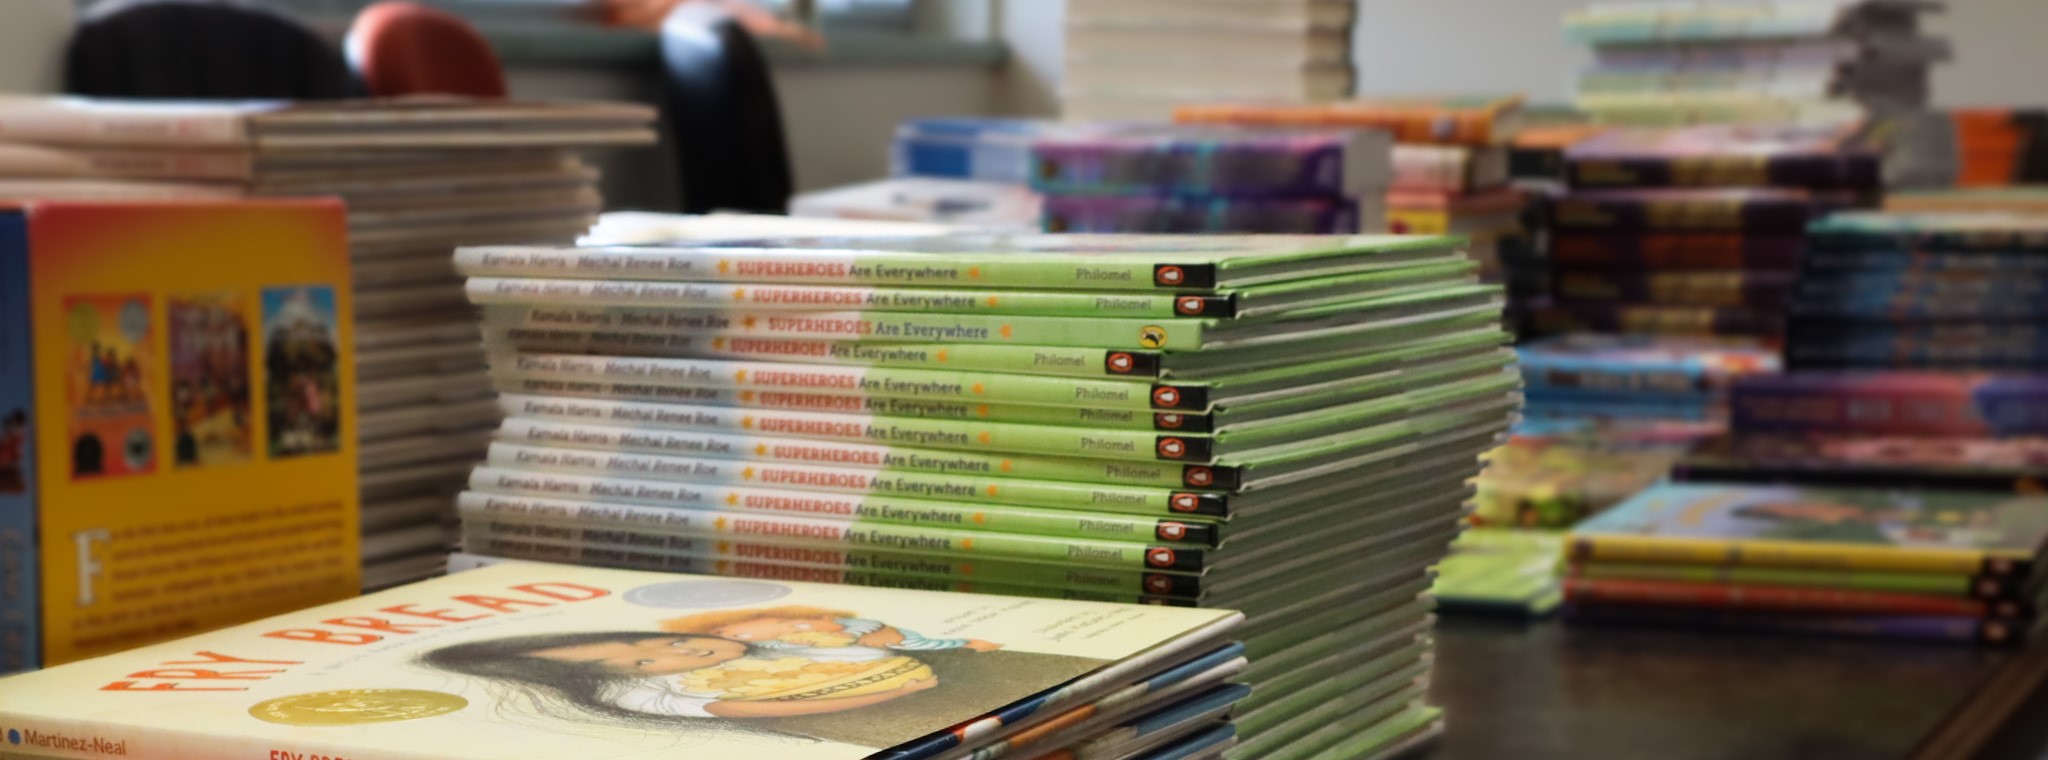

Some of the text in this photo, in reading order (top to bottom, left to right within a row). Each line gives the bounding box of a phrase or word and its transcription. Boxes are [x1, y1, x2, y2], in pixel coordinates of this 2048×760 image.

[529, 254, 566, 267] Harris
[625, 256, 664, 269] Renee
[668, 257, 692, 269] Roe
[737, 262, 844, 276] SUPERHEROES
[848, 264, 870, 278] Are
[875, 264, 957, 281] Everywhere
[1076, 269, 1131, 281] Philomel
[752, 289, 862, 305] SUPERHEROES
[866, 293, 889, 306] Are
[893, 292, 975, 309] Everywhere
[1095, 298, 1151, 310] Philomel
[768, 318, 871, 335] SUPERHEROES
[875, 321, 899, 336] Are
[903, 322, 989, 341] Everywhere
[731, 341, 826, 357] SUPERHEROES
[829, 345, 850, 358] Are
[854, 345, 927, 363] Everywhere
[1034, 353, 1085, 367] Philomel
[754, 371, 855, 389] SUPERHEROES
[859, 377, 879, 390] Are
[885, 378, 962, 395] Everywhere
[1075, 386, 1128, 401] Philomel
[760, 391, 863, 411] SUPERHEROES
[865, 397, 886, 411] Are
[890, 398, 968, 418] Everywhere
[1080, 409, 1132, 422] Philomel
[567, 403, 600, 416] Harris
[657, 409, 692, 422] Renee
[695, 411, 718, 424] Roe
[760, 418, 862, 437] SUPERHEROES
[865, 424, 886, 439] Are
[891, 425, 968, 444] Everywhere
[1081, 438, 1134, 452] Philomel
[572, 429, 608, 443] Harris
[665, 435, 703, 450] Renee
[706, 438, 730, 451] Roe
[774, 446, 879, 466] SUPERHEROES
[883, 453, 905, 467] Are
[910, 454, 990, 473] Everywhere
[1106, 464, 1160, 480] Philomel
[560, 452, 597, 466] Harris
[653, 459, 690, 472] Renee
[694, 462, 717, 475] Roe
[761, 468, 866, 488] SUPERHEROES
[870, 476, 892, 490] Are
[896, 476, 976, 497] Everywhere
[1092, 491, 1146, 505] Philomel
[543, 479, 579, 493] Harris
[637, 486, 674, 499] Renee
[678, 488, 702, 501] Roe
[745, 495, 851, 515] SUPERHEROES
[855, 504, 878, 518] Are
[881, 504, 962, 524] Everywhere
[1079, 519, 1134, 535] Philomel
[734, 520, 840, 541] SUPERHEROES
[843, 529, 866, 543] Are
[870, 530, 950, 550] Everywhere
[1068, 545, 1122, 561] Philomel
[736, 543, 841, 564] SUPERHEROES
[845, 553, 867, 566] Are
[871, 555, 951, 573] Everywhere
[98, 650, 305, 691] FRY
[259, 581, 613, 646] BREAD
[24, 728, 126, 756] Martinez-Neal
